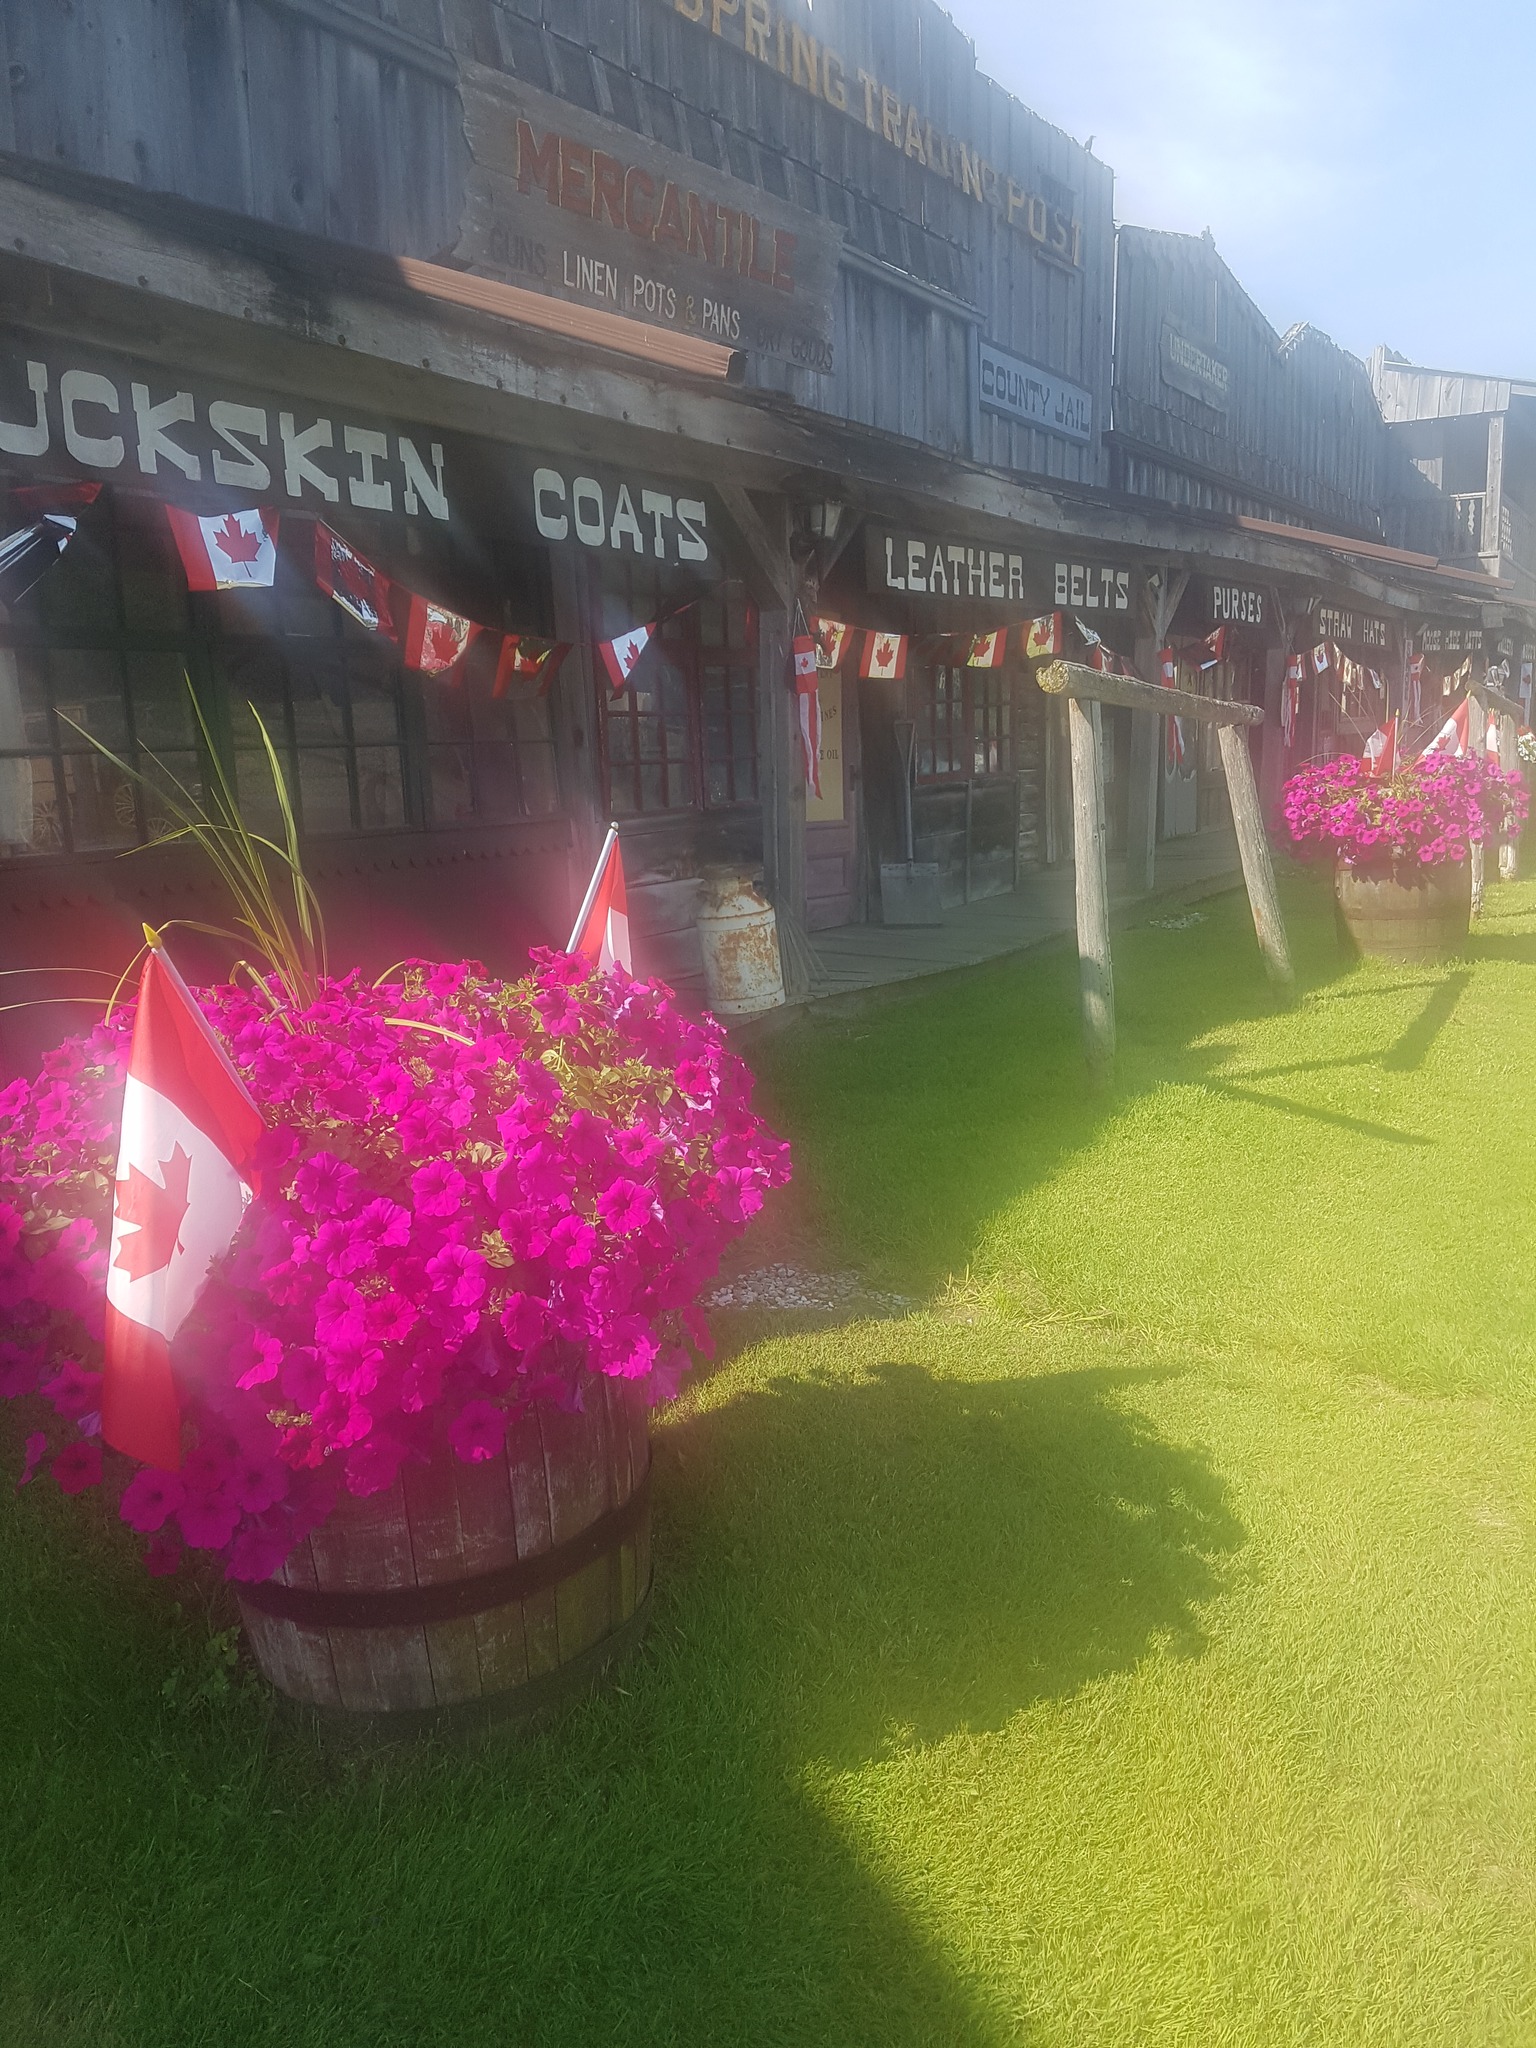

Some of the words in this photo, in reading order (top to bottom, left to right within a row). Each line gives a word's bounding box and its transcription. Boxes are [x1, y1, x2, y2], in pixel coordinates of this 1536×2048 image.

[516, 117, 799, 293] MERCANTILE
[1007, 176, 1081, 267] POST
[563, 250, 618, 301] LINEN
[633, 274, 677, 319] POTS
[702, 298, 741, 340] PANS
[981, 358, 1050, 417] COUNTY
[1055, 391, 1090, 433] JAIL
[1169, 332, 1228, 392] UNDERTAKER
[533, 467, 709, 562] COATS
[885, 537, 1024, 600] LEATHER
[1054, 562, 1129, 610] BELTS
[1213, 586, 1262, 623] PURSES
[1319, 608, 1353, 639] STRAW
[1363, 618, 1386, 646] HATS
